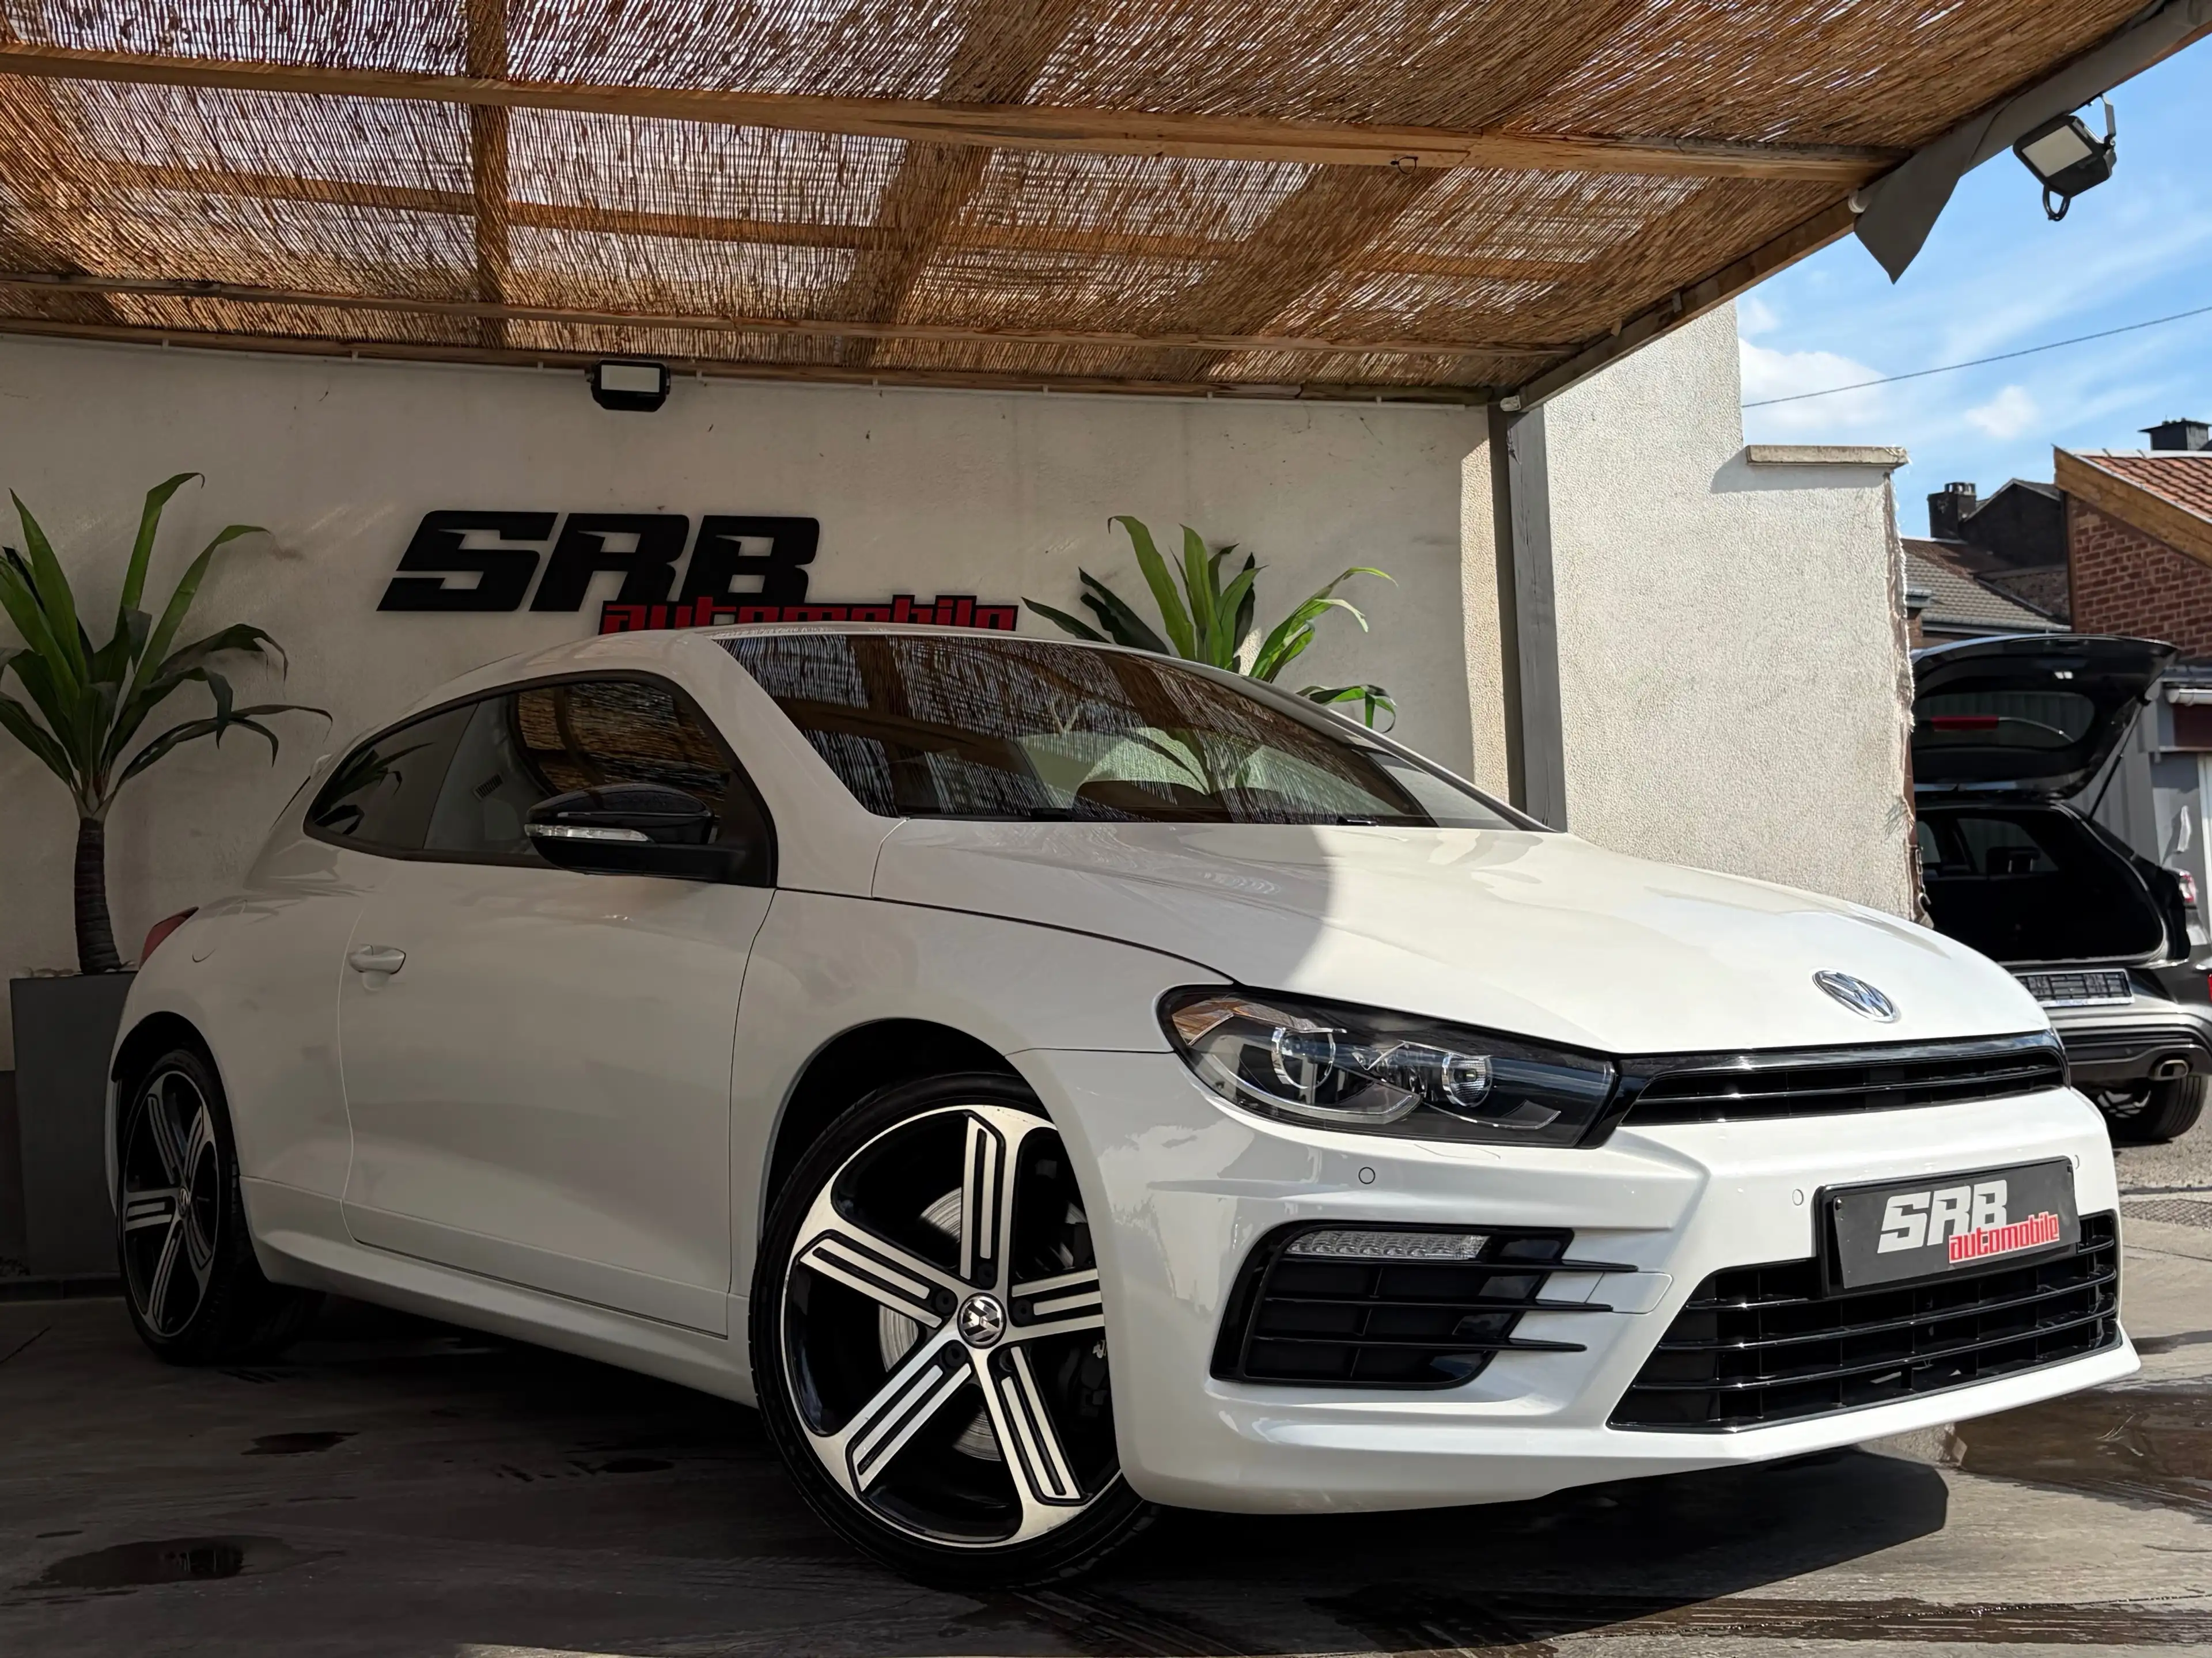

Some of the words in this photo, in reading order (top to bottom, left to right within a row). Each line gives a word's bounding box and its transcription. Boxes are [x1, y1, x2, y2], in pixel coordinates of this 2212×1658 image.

[376, 510, 820, 612] SRB
[603, 595, 1018, 635] autil
[1877, 1179, 2008, 1254] SRB
[1948, 1211, 2061, 1264] automobile
